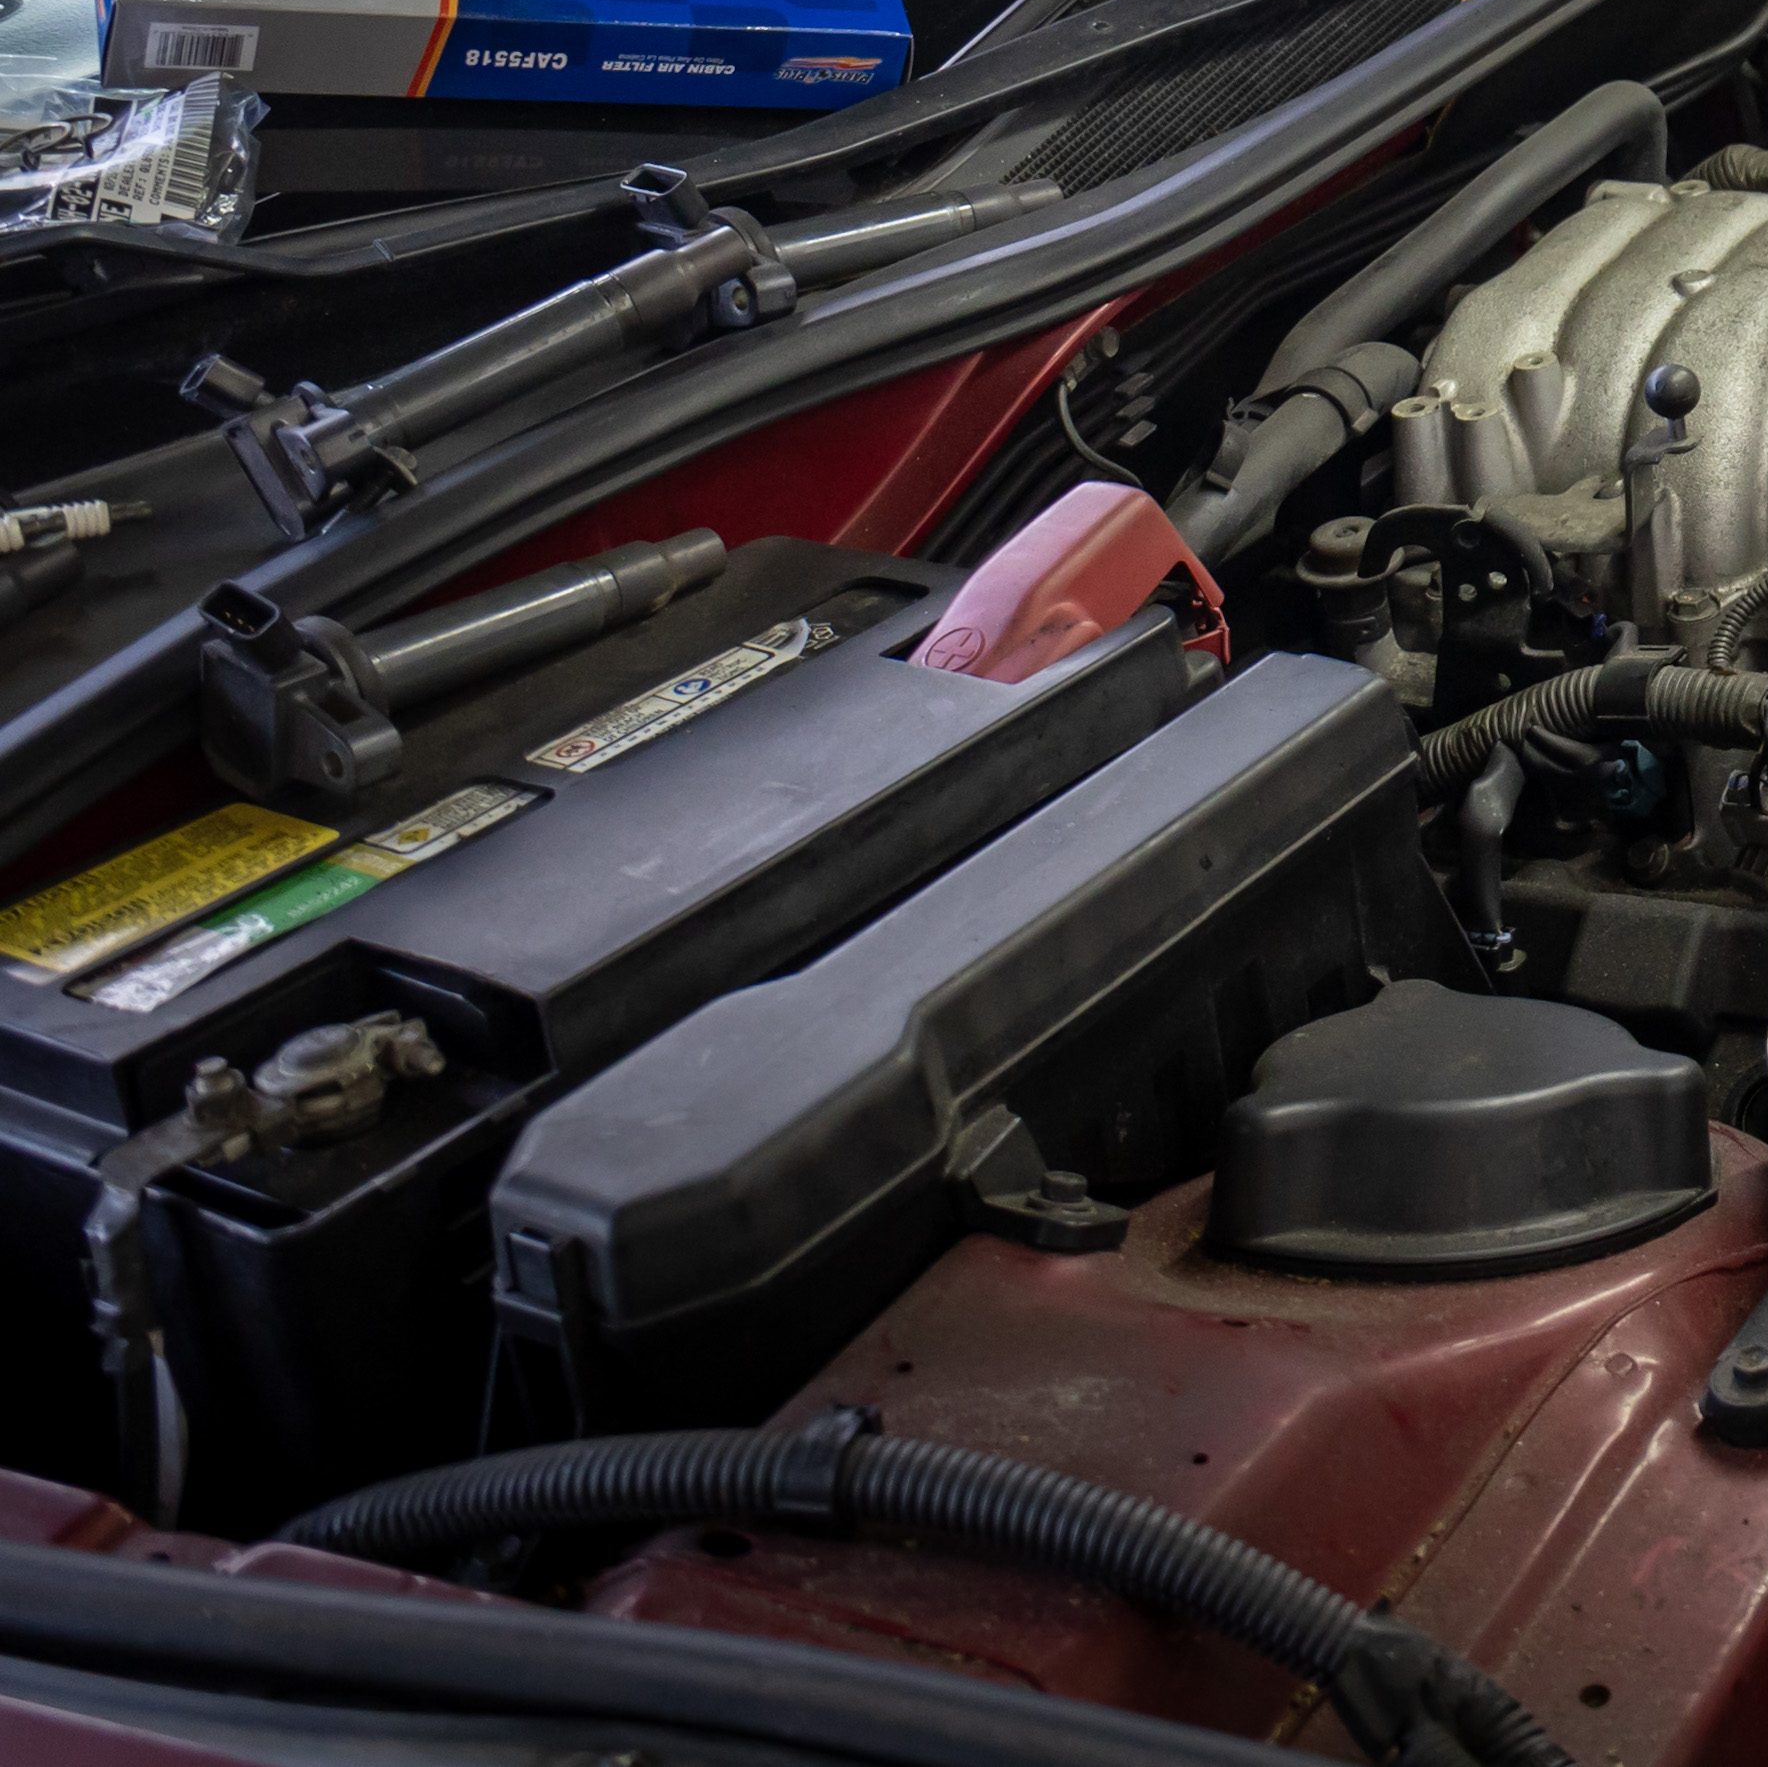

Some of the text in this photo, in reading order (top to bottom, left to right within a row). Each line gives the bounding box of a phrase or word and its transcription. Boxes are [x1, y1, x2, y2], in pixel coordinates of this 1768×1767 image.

[465, 49, 568, 70] CAF5518
[601, 60, 736, 75] CABIN AIR FILTER
[149, 154, 171, 206] COMMENTS:
